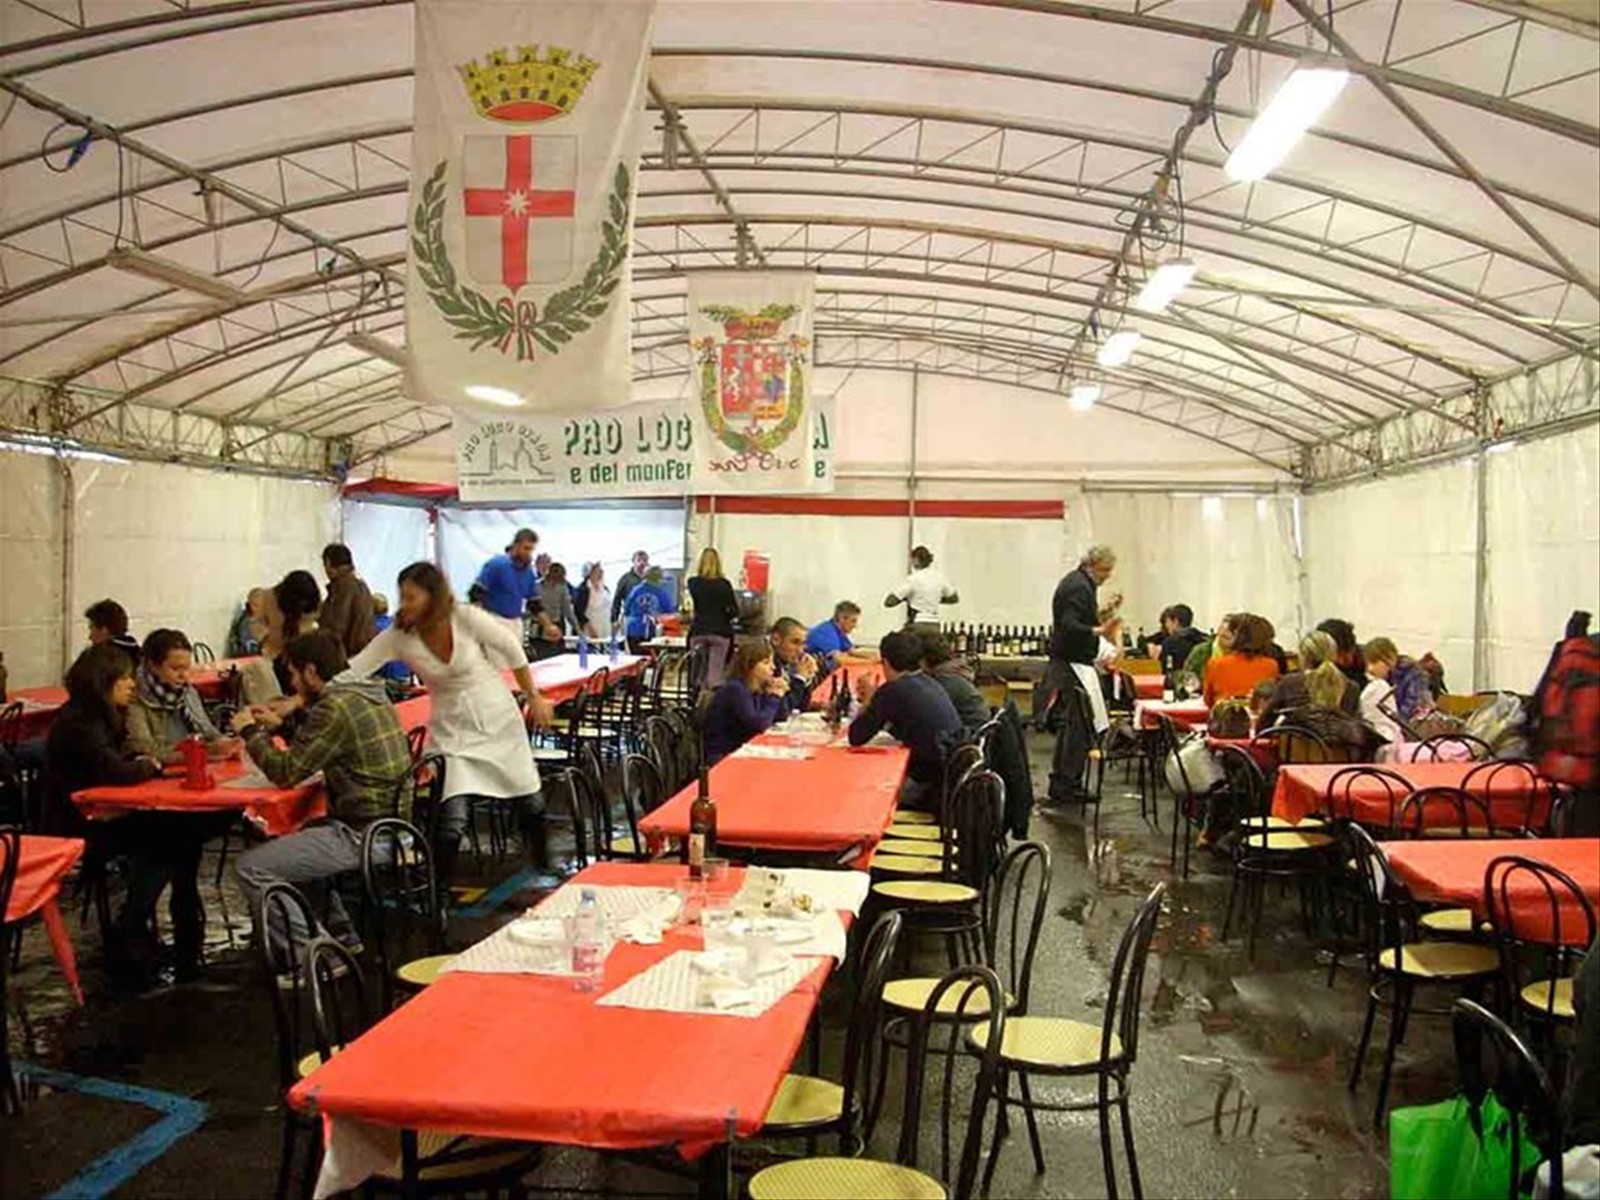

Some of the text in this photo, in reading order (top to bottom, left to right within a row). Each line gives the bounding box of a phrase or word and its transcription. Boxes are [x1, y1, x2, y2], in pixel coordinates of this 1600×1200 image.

[564, 418, 623, 456] PRO
[637, 411, 693, 453] LOC
[570, 466, 582, 484] e
[590, 462, 618, 483] del
